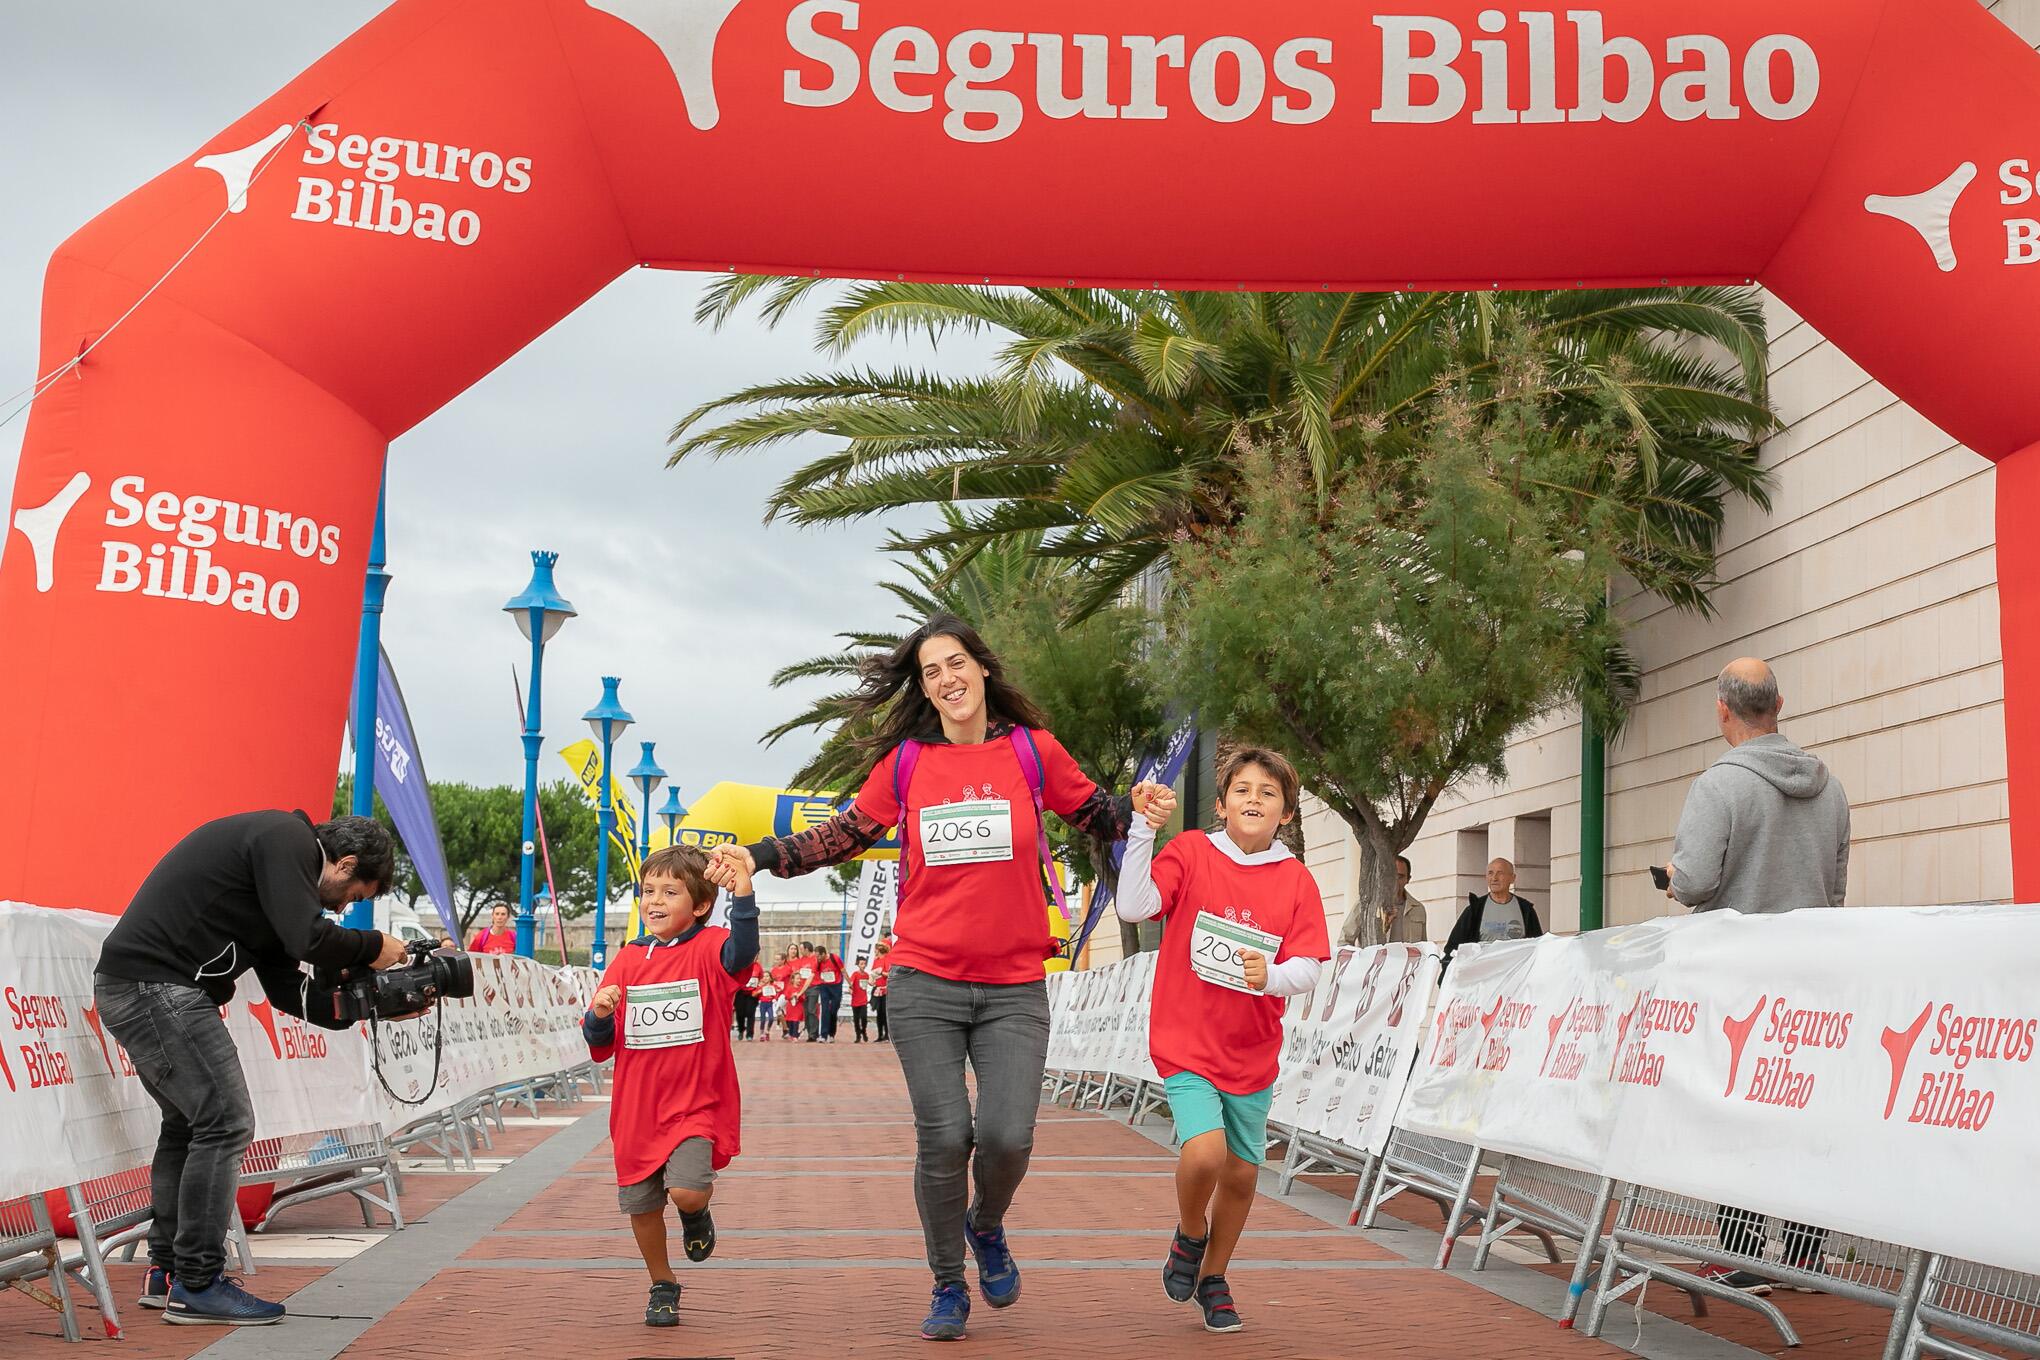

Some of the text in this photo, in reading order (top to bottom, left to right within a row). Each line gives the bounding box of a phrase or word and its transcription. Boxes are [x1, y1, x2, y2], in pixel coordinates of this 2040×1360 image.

[783, 0, 1820, 143] Seguros Bilbao
[302, 123, 532, 193] Seguros
[291, 177, 480, 246] Bilbao
[105, 475, 340, 565] Seguros
[96, 541, 300, 621] Bilbao
[928, 820, 991, 842] 2066
[5, 987, 67, 1038] Seguros
[1764, 997, 1853, 1055] Seguros
[1930, 1003, 2038, 1069] Seguros
[20, 1042, 74, 1088] Bilbao
[1619, 1041, 1665, 1087] Bilbao
[1745, 1057, 1815, 1109] Bilbao
[1908, 1072, 1996, 1132] Bilbao
